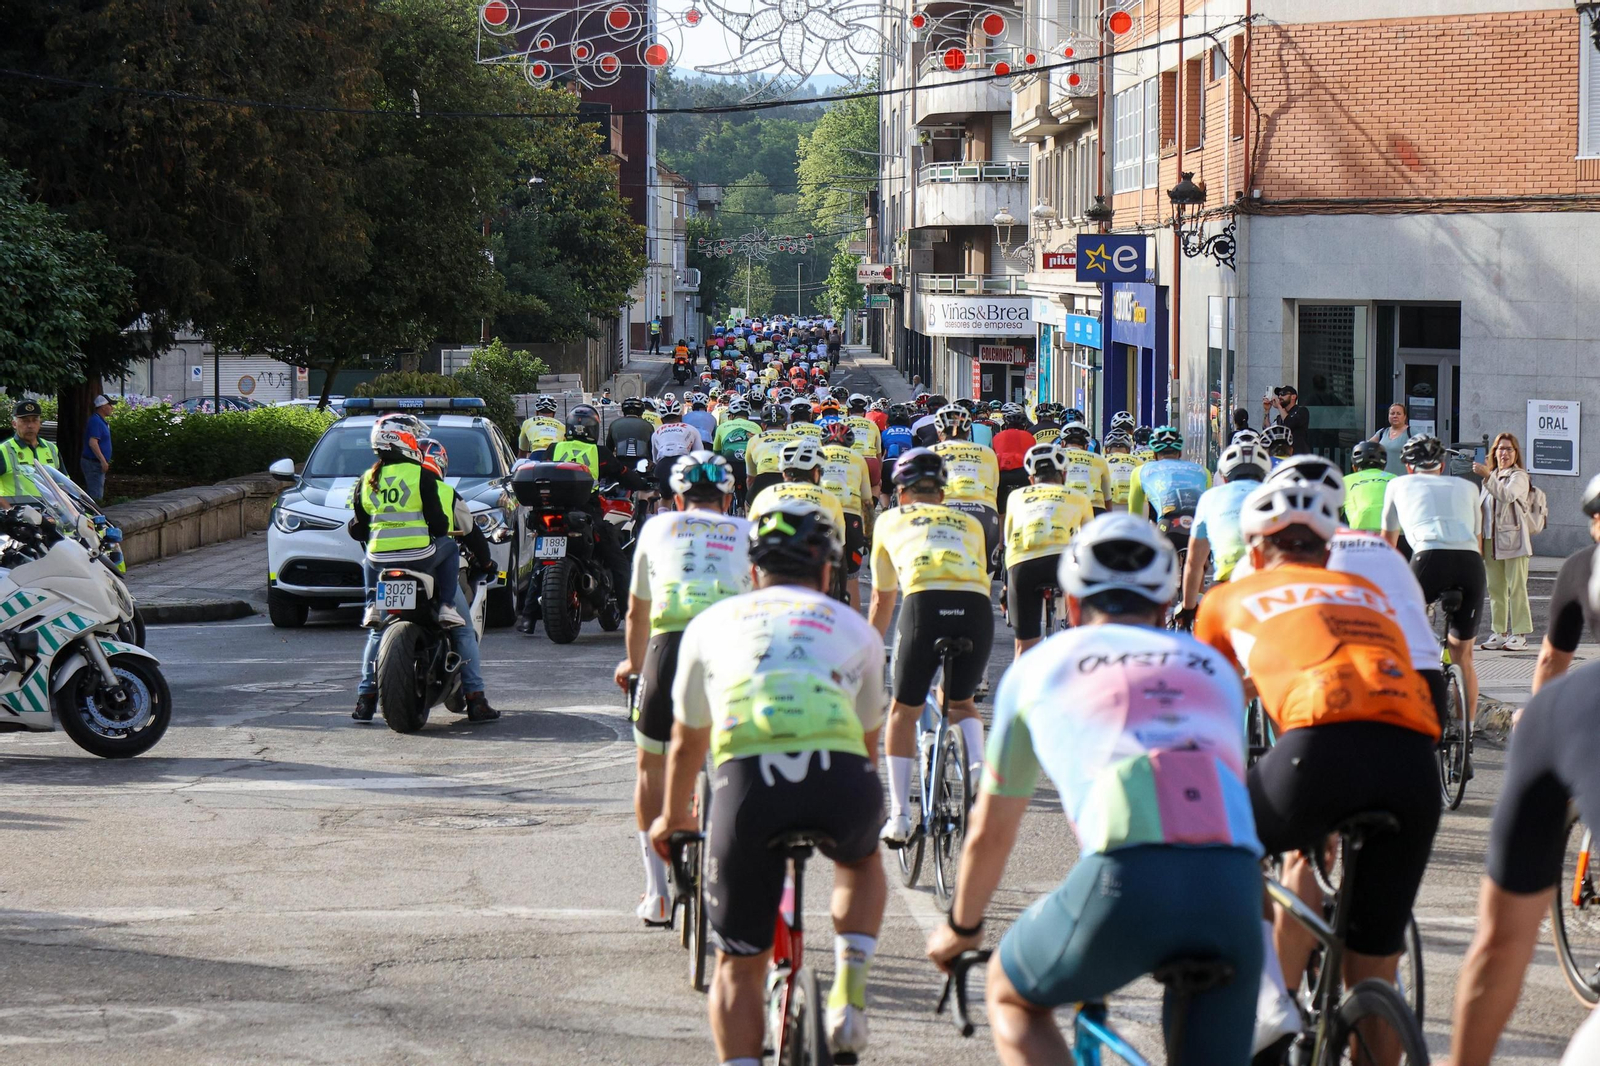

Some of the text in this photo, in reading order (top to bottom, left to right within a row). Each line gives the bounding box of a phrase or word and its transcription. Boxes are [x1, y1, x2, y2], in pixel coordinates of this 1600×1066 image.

[1112, 245, 1138, 273] e
[941, 302, 1030, 321] Viñas&Brea
[944, 320, 1023, 330] asesores de empresa
[981, 346, 1013, 362] COLCHONES
[1538, 416, 1568, 430] ORAL
[381, 487, 400, 504] 10
[545, 538, 566, 548] 1893
[542, 547, 560, 556] JJM
[386, 583, 414, 596] 3026
[385, 595, 406, 608] GFV
